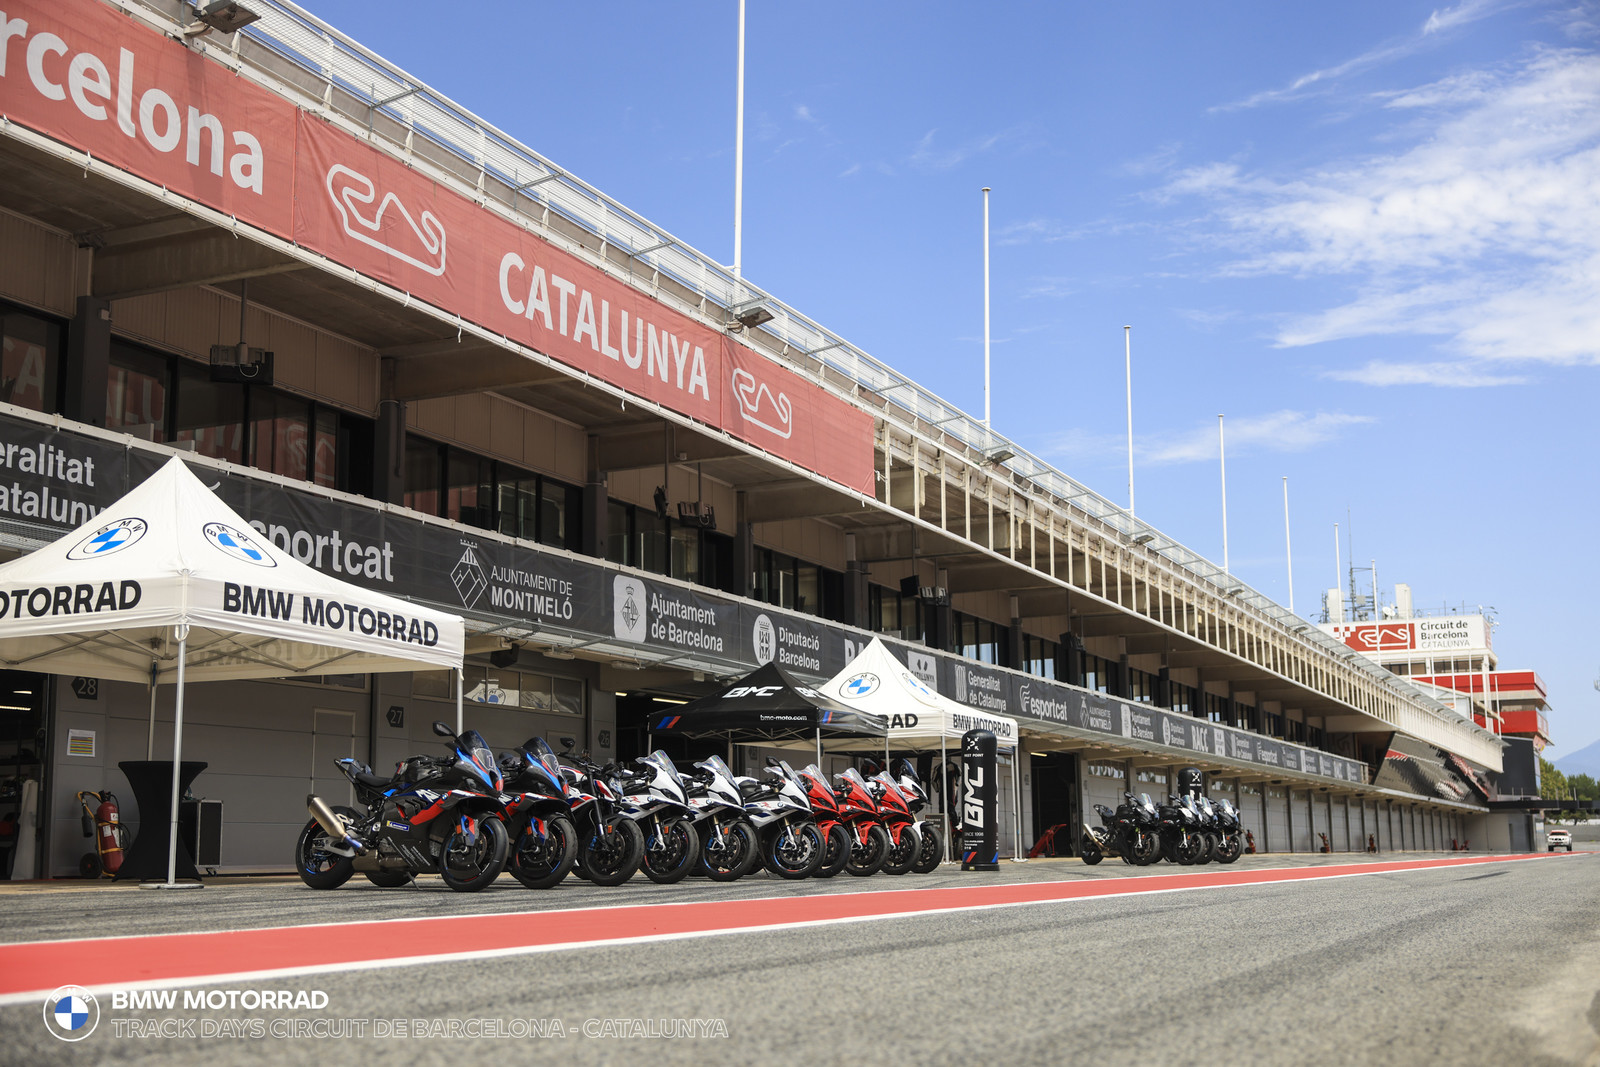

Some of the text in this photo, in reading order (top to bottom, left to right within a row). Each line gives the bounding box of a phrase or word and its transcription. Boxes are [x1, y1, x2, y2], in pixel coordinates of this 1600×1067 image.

[499, 251, 710, 402] CATALUNYA
[490, 565, 573, 597] AJUNTAMENT DE
[223, 581, 439, 647] BMW MOTORRAD
[491, 585, 573, 620] MONTMELÓ
[650, 592, 716, 626] Ajuntament
[651, 618, 723, 652] de Barcelona
[1420, 620, 1468, 631] Circuit de
[1421, 630, 1468, 640] Barcelona
[778, 626, 820, 651] Diputació
[1421, 640, 1470, 649] CATALUNYA
[779, 647, 820, 671] Barcelona
[77, 677, 97, 696] 28
[967, 670, 1001, 692] Generalitat
[969, 690, 1006, 713] de Catalunya
[1030, 696, 1068, 721] esportcat
[390, 709, 403, 724] 27
[953, 714, 1011, 737] BMW MOTORRAD
